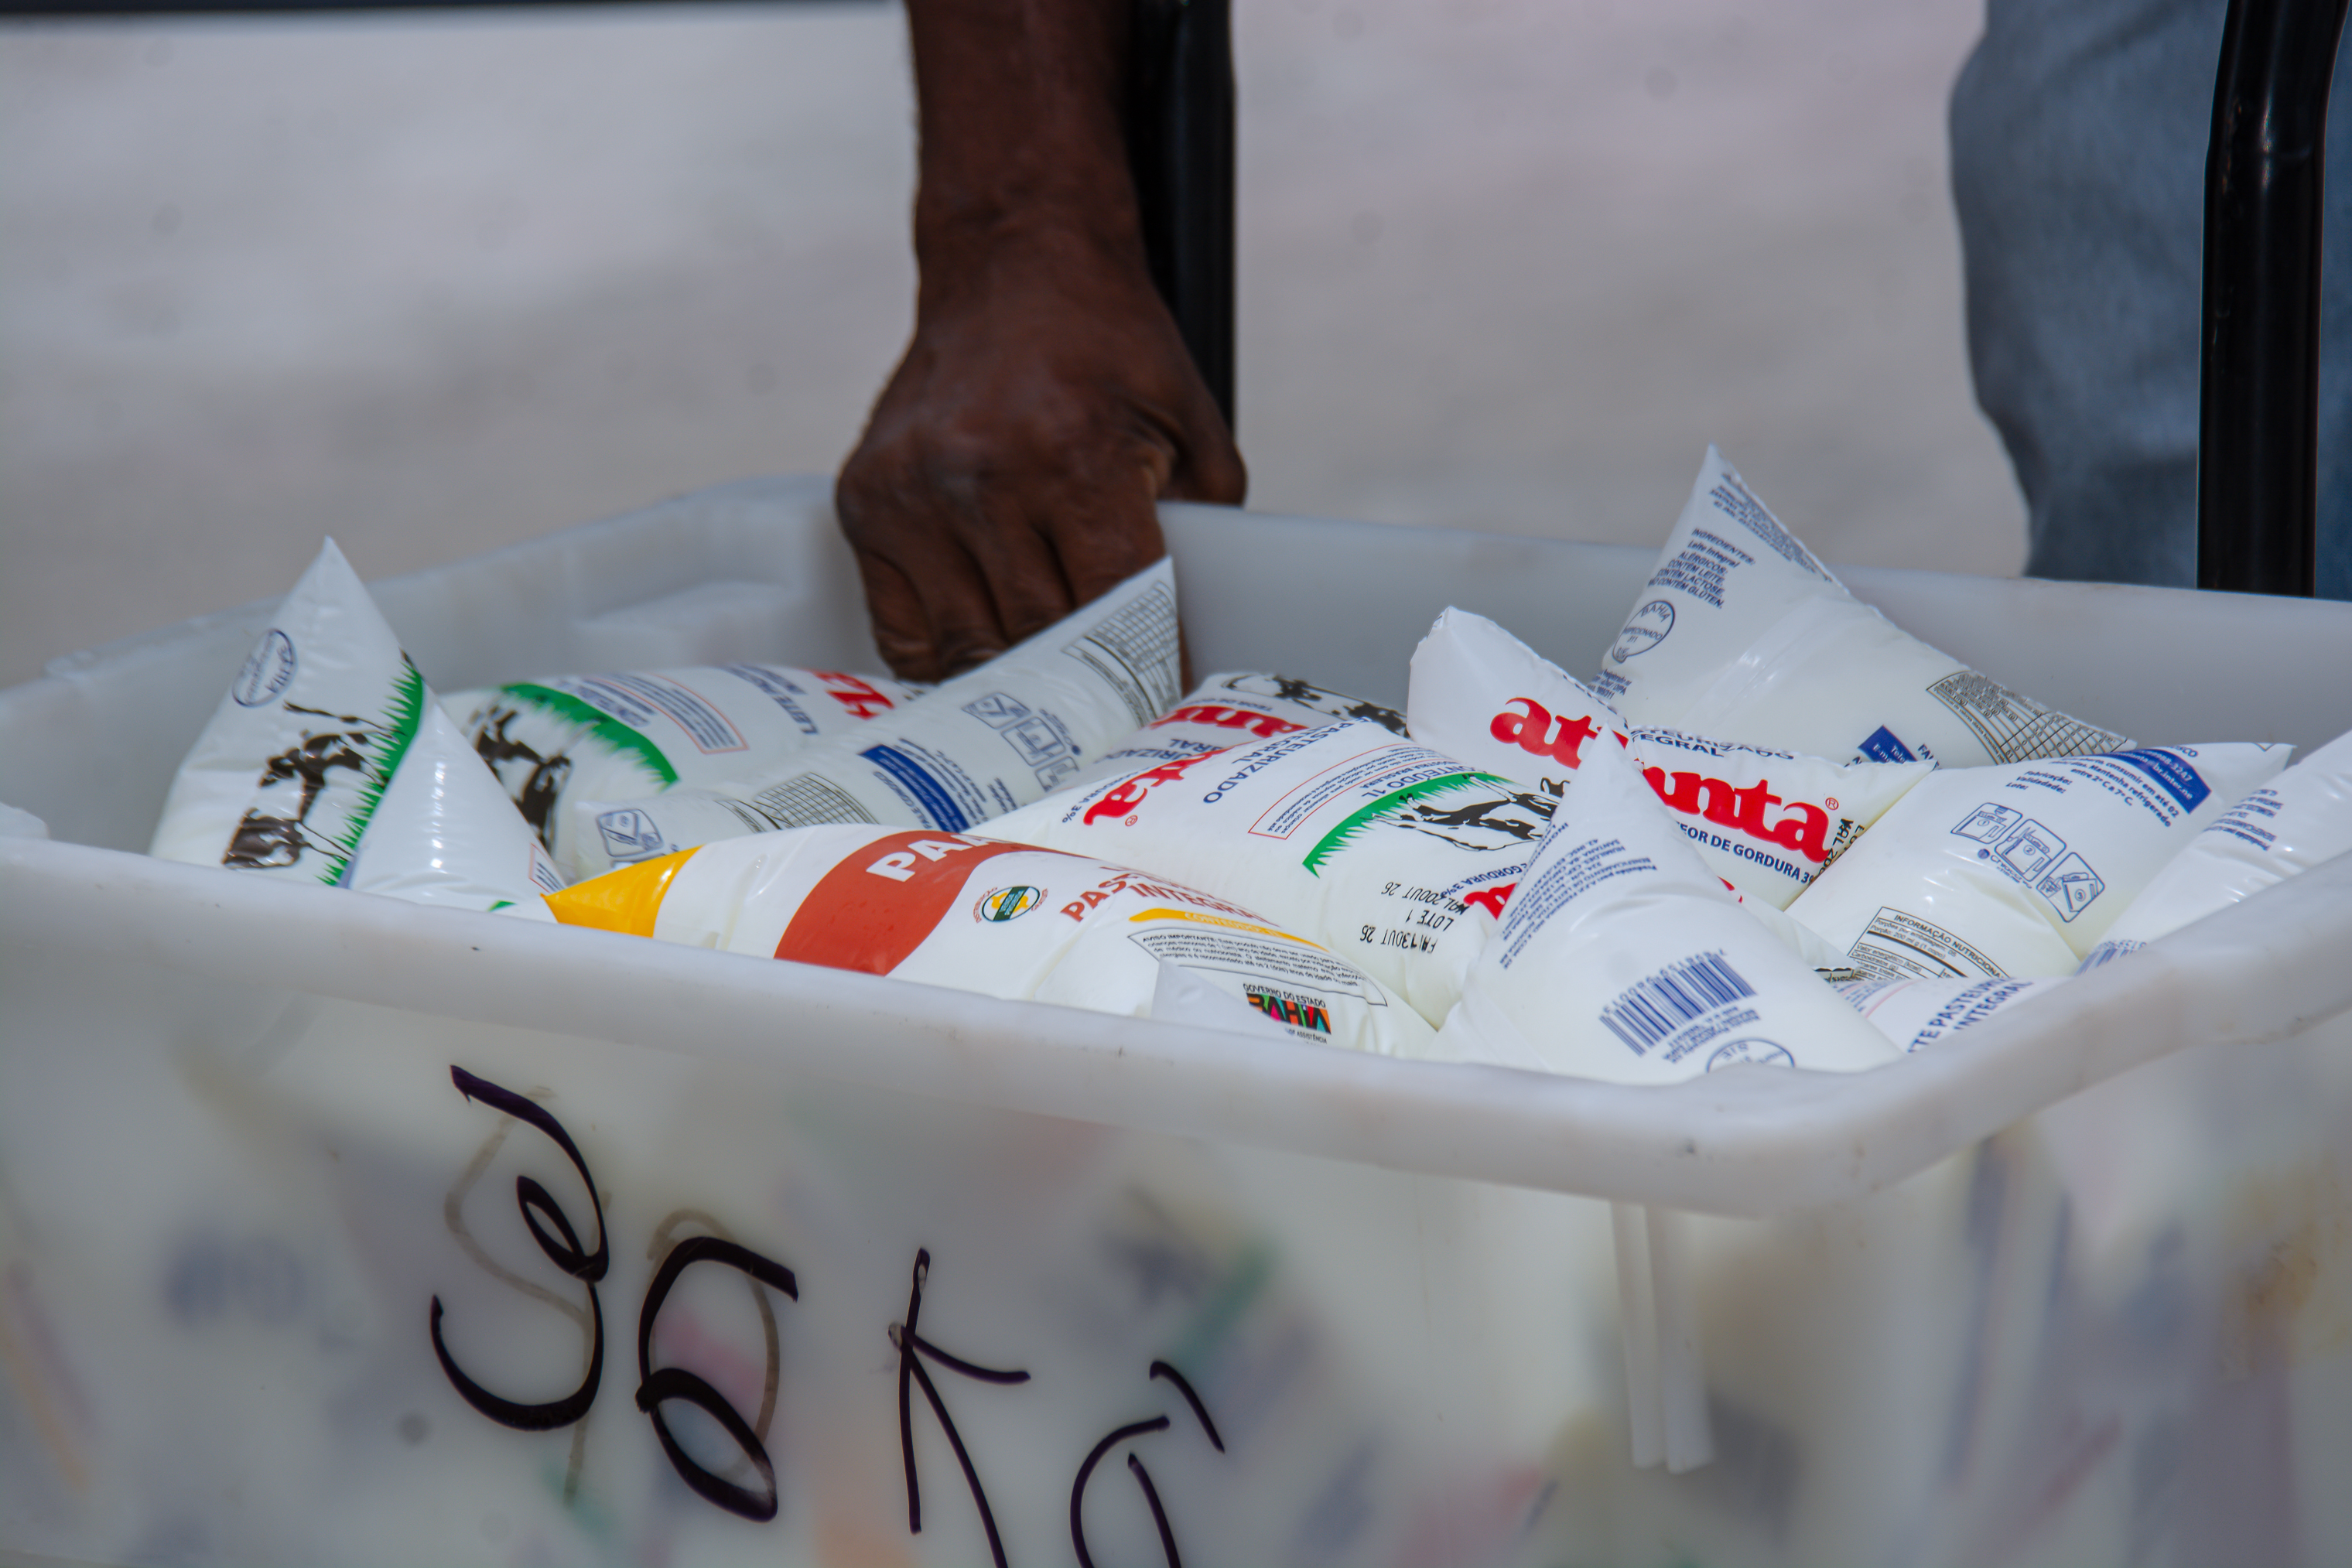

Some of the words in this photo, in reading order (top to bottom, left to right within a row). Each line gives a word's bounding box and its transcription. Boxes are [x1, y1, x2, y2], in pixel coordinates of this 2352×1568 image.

[1677, 550, 1728, 576] ALÉRGICOS:
[1639, 603, 1671, 623] BAHIA
[1202, 721, 1356, 804] PASTEURIZADO
[2005, 781, 2029, 791] Lote:
[2088, 764, 2129, 789] Mantenha
[2128, 785, 2173, 828] refrigerado
[2105, 760, 2144, 785] consumir
[2142, 782, 2156, 796] em
[2154, 791, 2171, 808] até
[2166, 804, 2180, 818] 02
[865, 833, 989, 883] PAA
[1710, 834, 1732, 852] DE
[1732, 842, 1803, 882] GORDURA
[1380, 881, 1402, 897] 26
[1128, 883, 1280, 927] INTEGRAL
[1416, 909, 1455, 932] LOTE
[1143, 934, 1167, 942] AVISO
[1167, 934, 1217, 944] IMPORTANTE:
[1359, 924, 1377, 944] 26
[1892, 931, 1906, 941] 200
[1893, 914, 1952, 945] INFORMAÇÃO
[1951, 939, 2005, 979] NUTRICIONA
[1243, 983, 1282, 999] GOVERNO
[1282, 990, 1296, 1001] DO
[1295, 995, 1327, 1009] ESTADO
